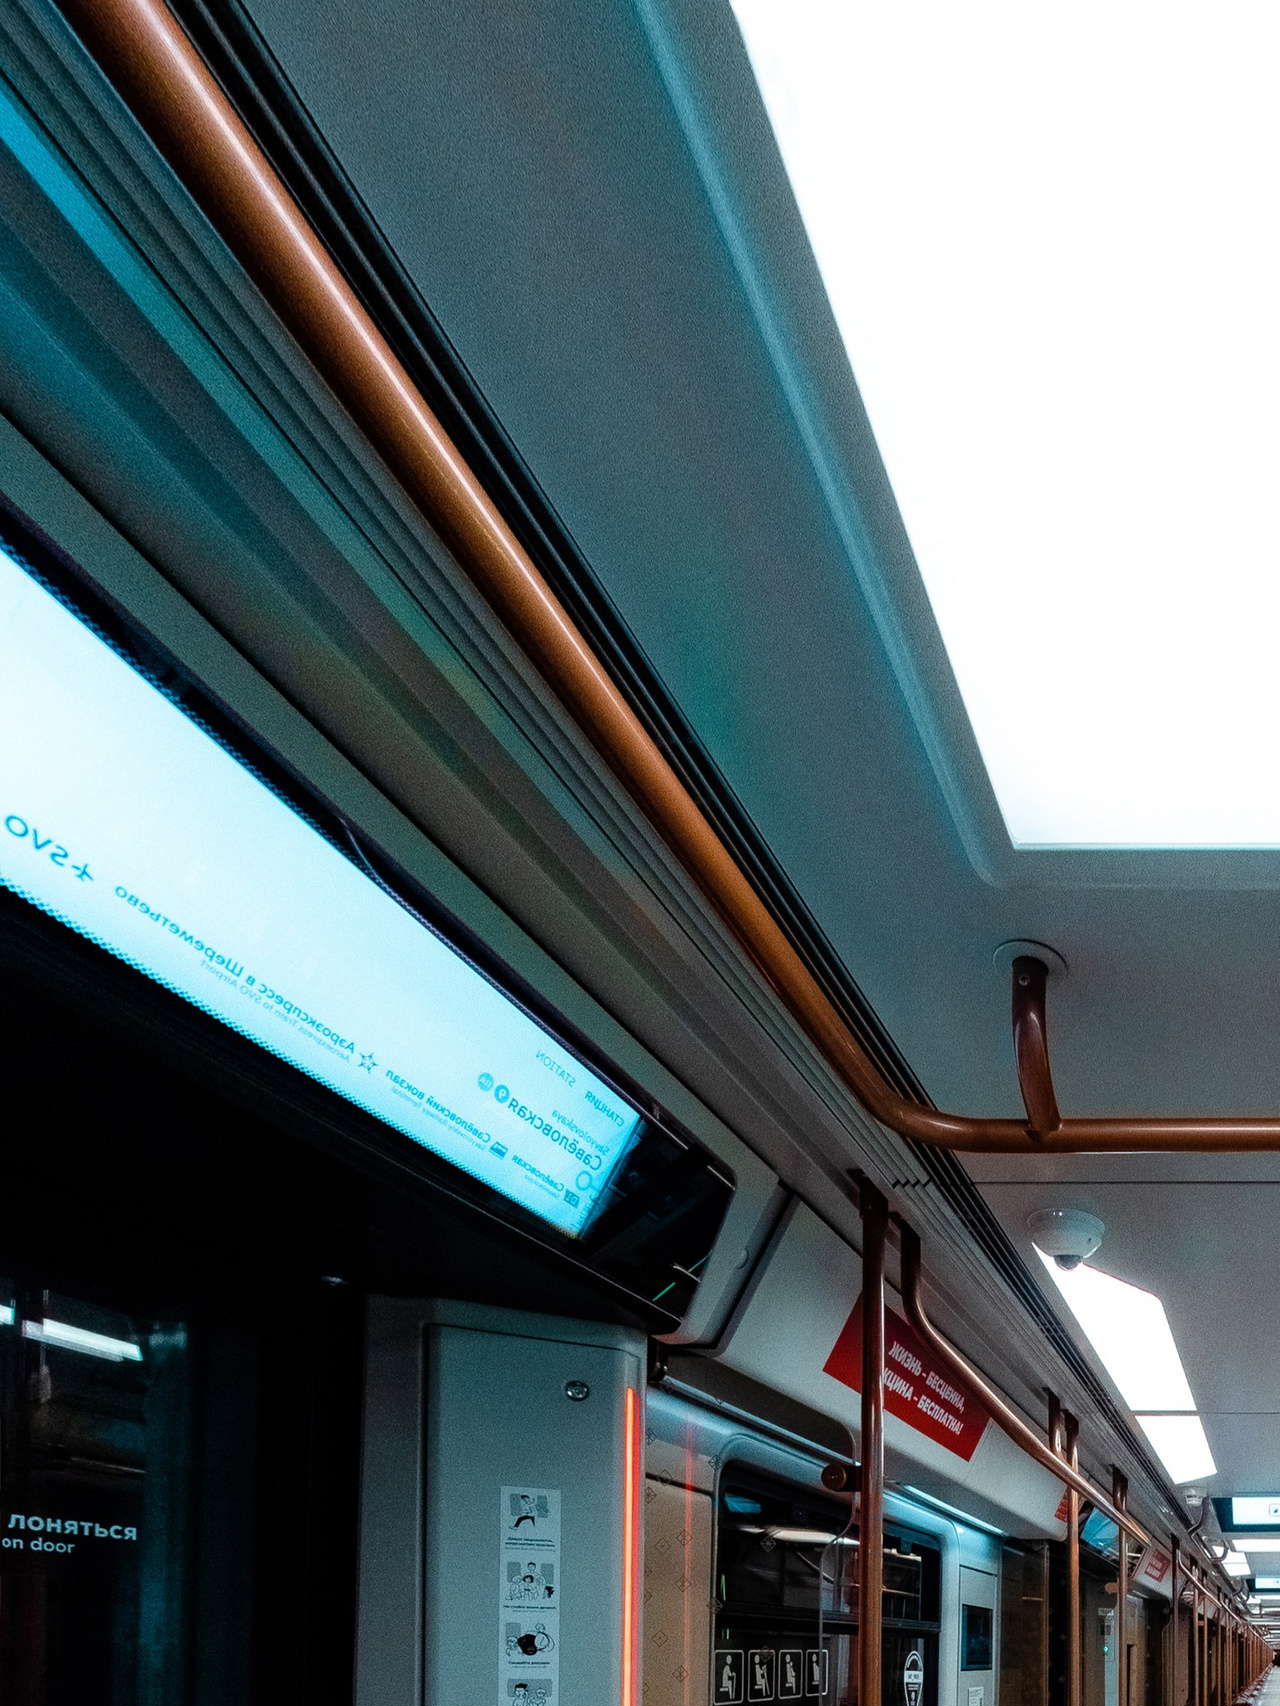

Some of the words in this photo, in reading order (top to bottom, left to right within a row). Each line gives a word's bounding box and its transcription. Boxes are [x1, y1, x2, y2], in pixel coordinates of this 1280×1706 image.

[884, 1368, 914, 1401] КЦИНА
[918, 1395, 963, 1435] БЕСПЛАТНА!
[888, 1341, 922, 1376] ЖИЗНЬ
[926, 1371, 965, 1413] БЕСЦЕННА,
[2, 1538, 23, 1549] on
[30, 1537, 75, 1553] door
